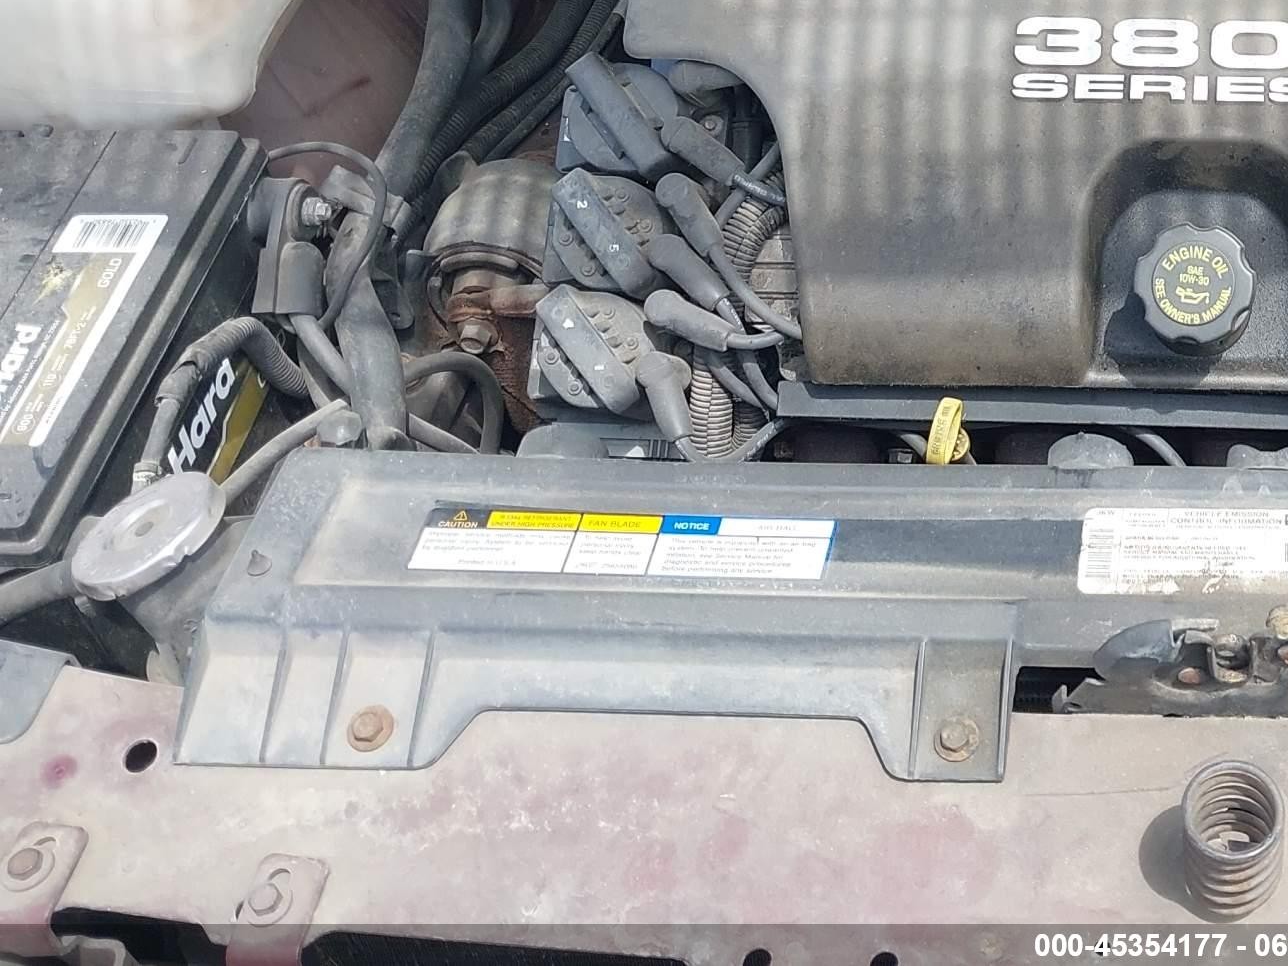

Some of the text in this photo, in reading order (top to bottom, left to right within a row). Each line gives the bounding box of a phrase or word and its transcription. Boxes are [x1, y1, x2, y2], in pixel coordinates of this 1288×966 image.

[1162, 245, 1229, 279] ENGINE OIL
[97, 257, 122, 289] GOLD
[1187, 265, 1204, 274] SAE
[1179, 273, 1209, 286] 10W-30
[1155, 278, 1232, 324] SEE OWNER'S MANUAL
[1225, 511, 1270, 519] EMISSION
[438, 520, 479, 528] CAUTION
[588, 520, 641, 528] FAN BLADE
[674, 522, 710, 531] NOTICE
[1218, 518, 1283, 526] INFORMATION
